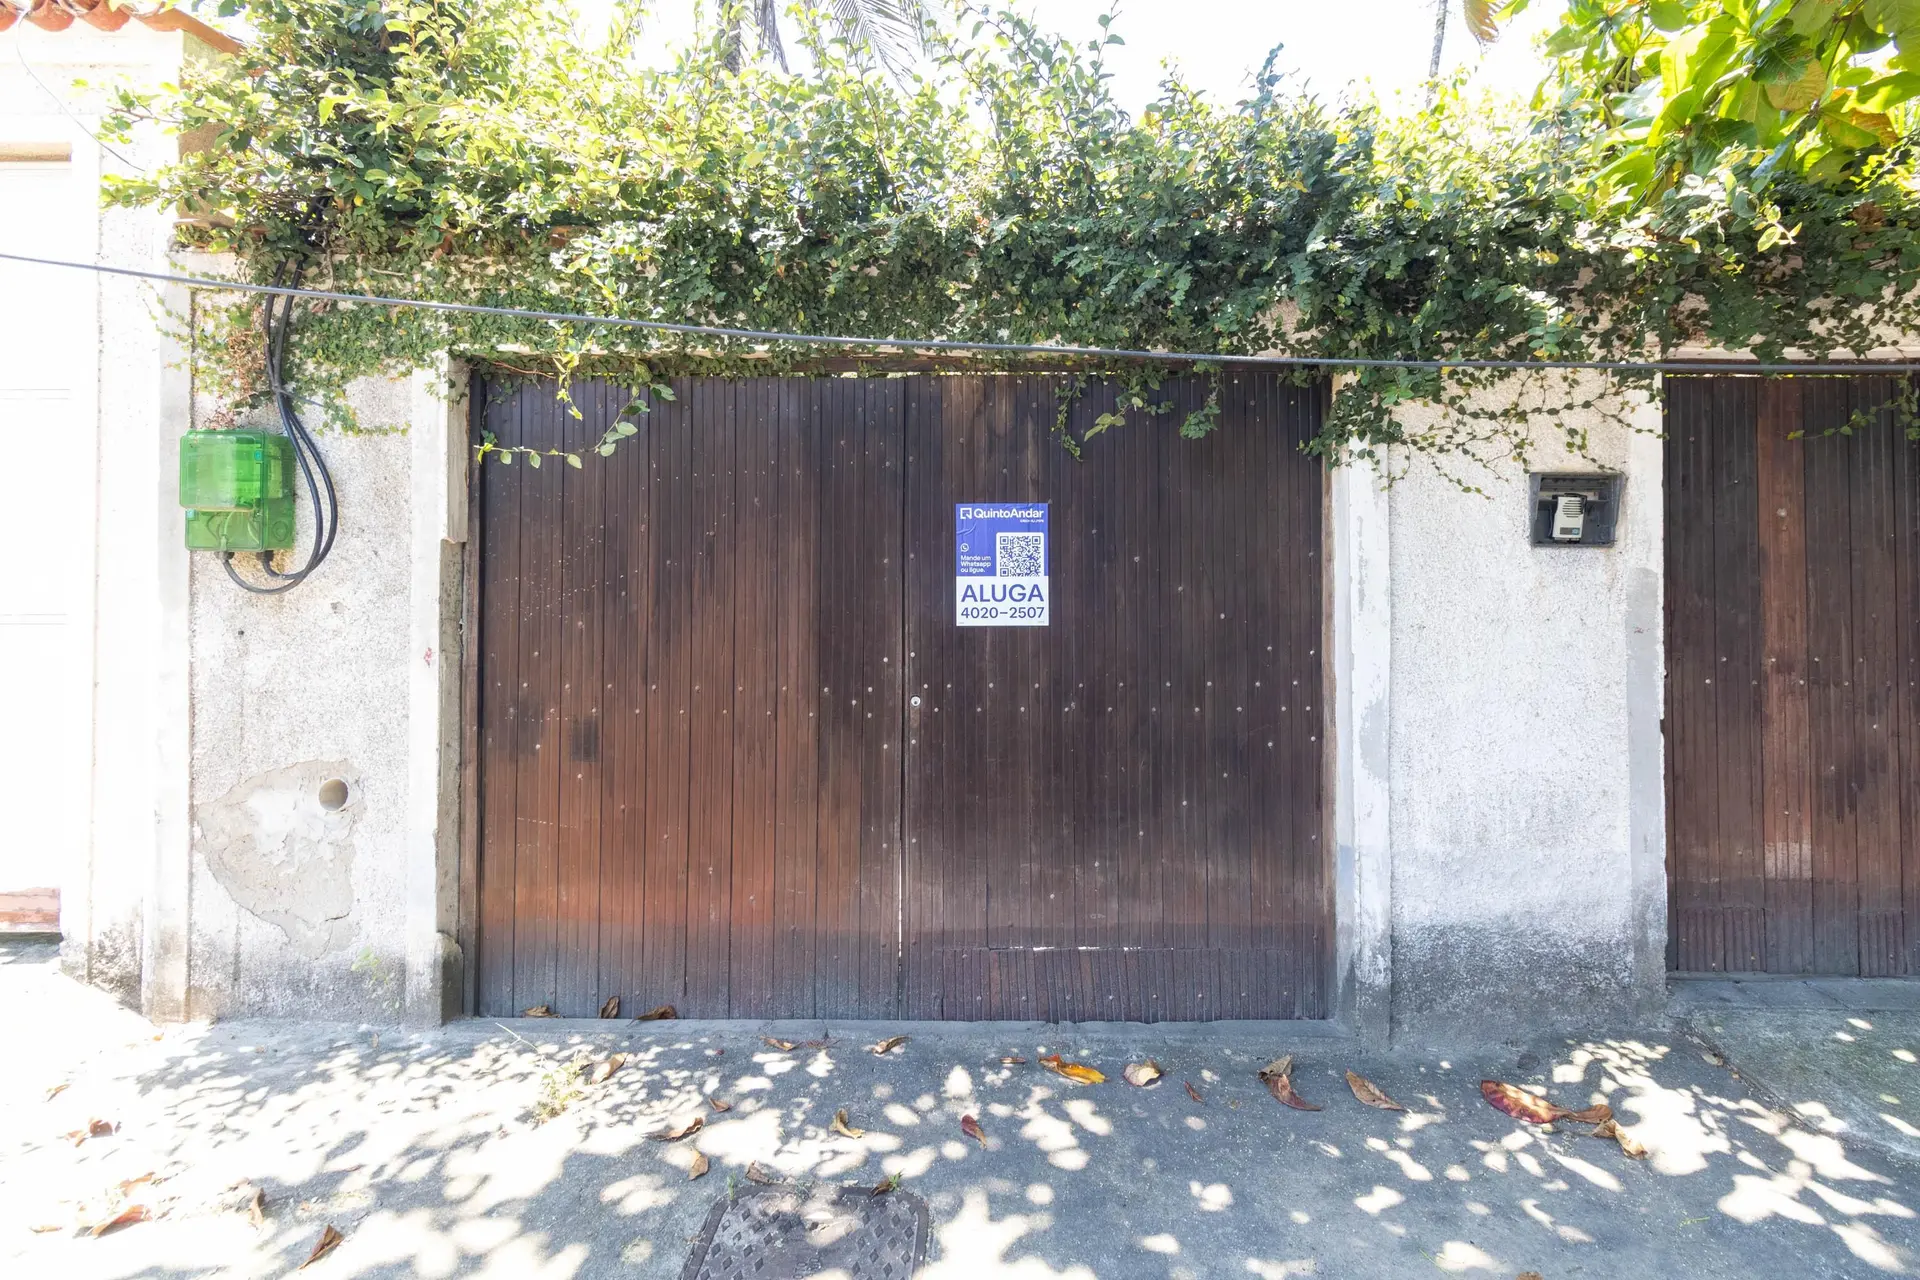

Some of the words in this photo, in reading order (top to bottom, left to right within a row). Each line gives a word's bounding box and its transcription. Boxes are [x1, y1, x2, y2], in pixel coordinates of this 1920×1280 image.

[974, 508, 1044, 519] QuintoAndar
[961, 584, 1044, 602] ALUGA
[961, 607, 1045, 619] 4020-2507
